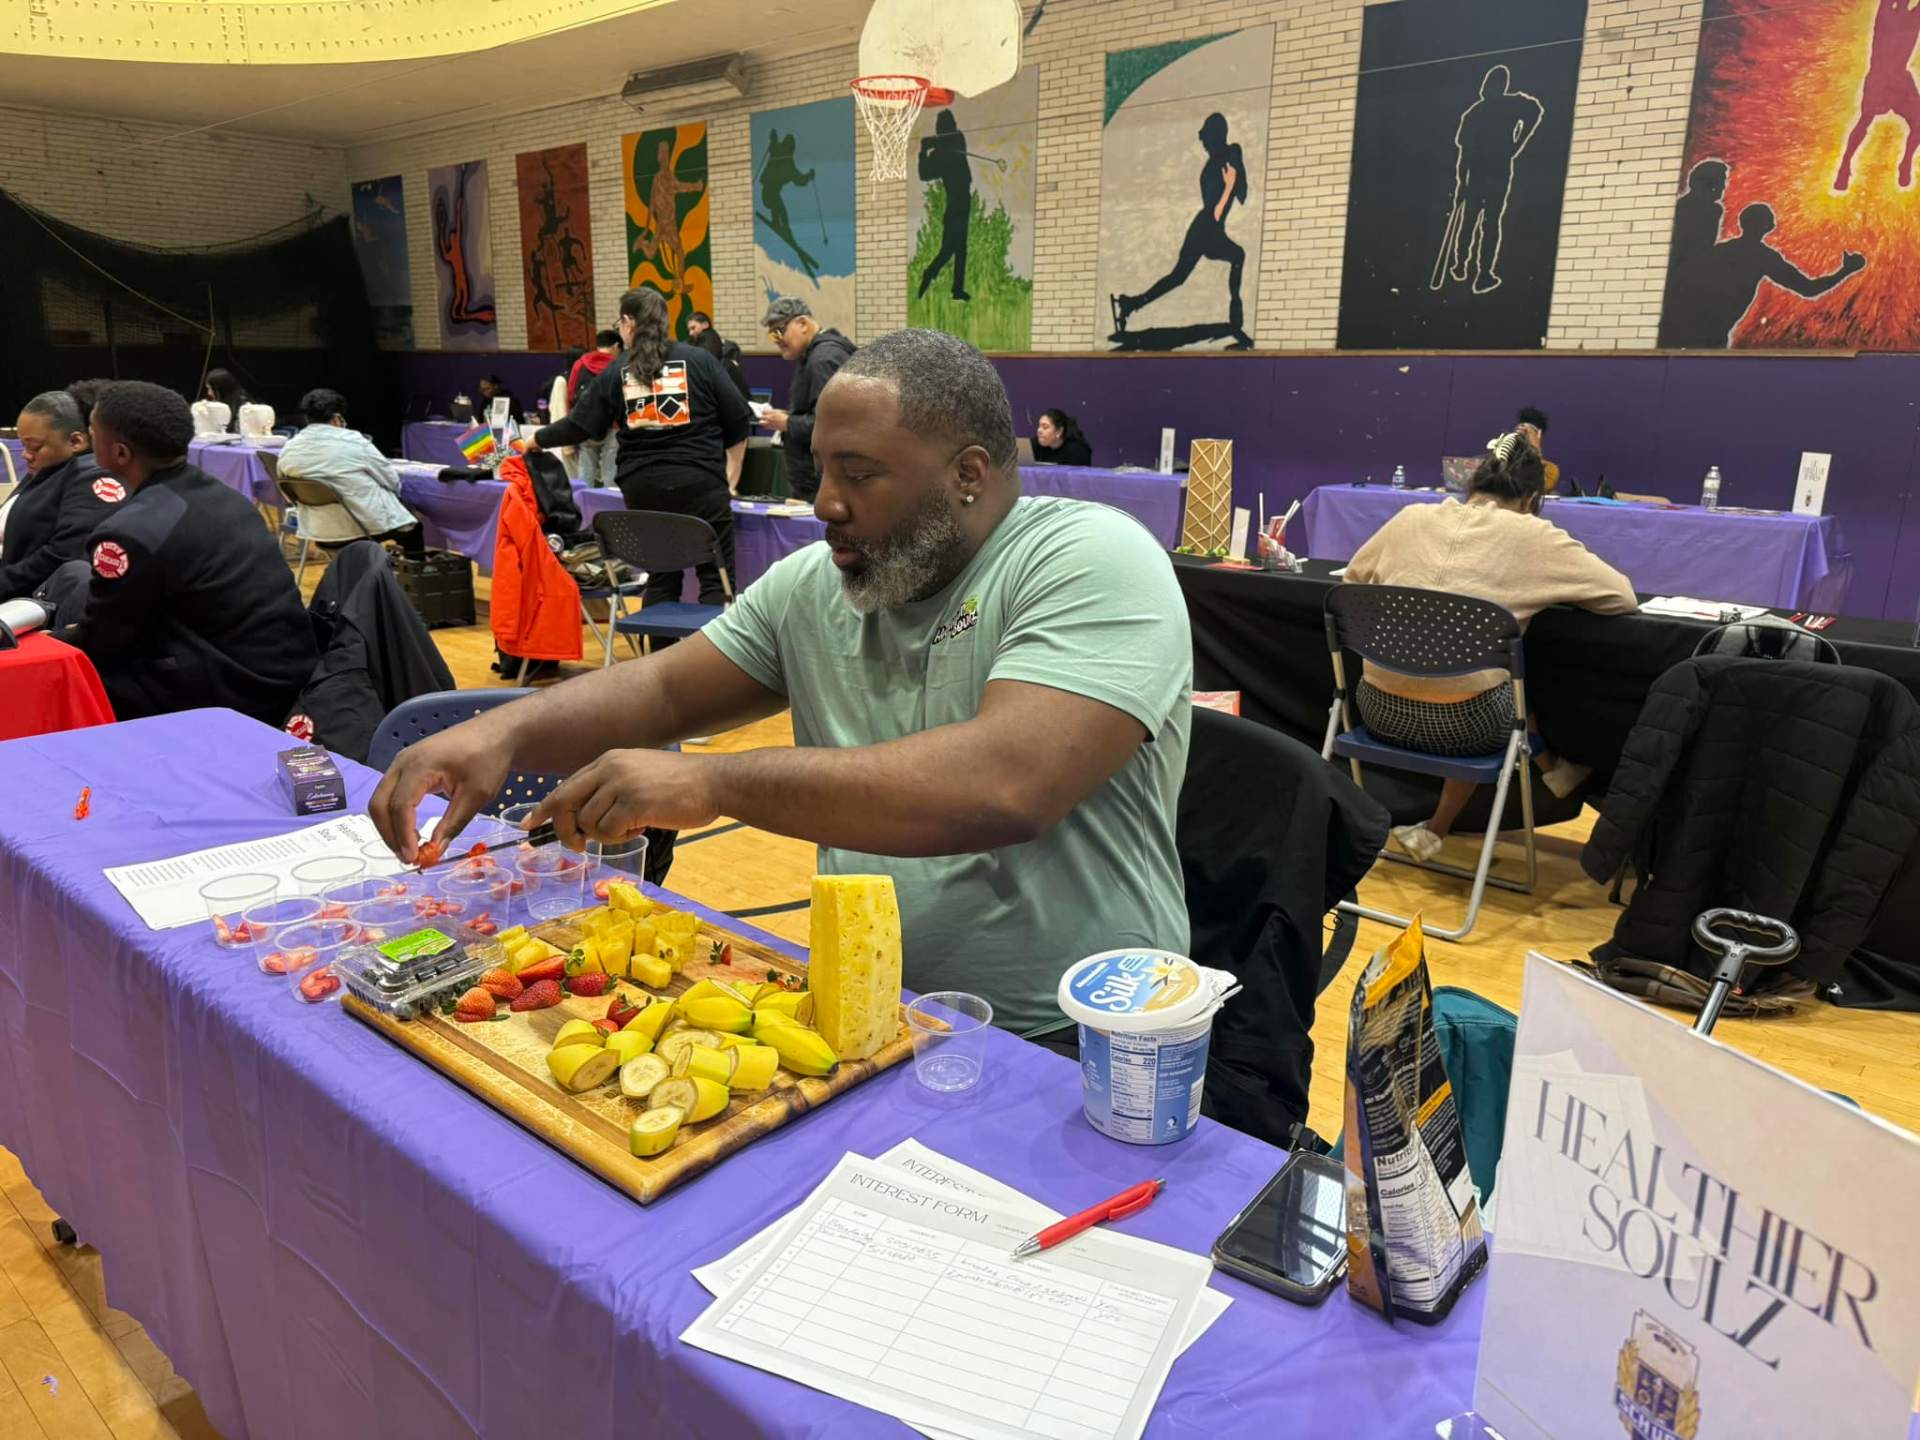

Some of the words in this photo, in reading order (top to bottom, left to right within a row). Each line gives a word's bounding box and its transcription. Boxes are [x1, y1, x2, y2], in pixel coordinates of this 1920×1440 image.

[1089, 972, 1147, 1012] Silk
[1139, 1034, 1157, 1042] Facts
[1143, 1057, 1156, 1065] 220
[850, 1173, 933, 1207] INTEREST
[932, 1200, 989, 1224] FORM
[1380, 1182, 1415, 1196] Calories
[1533, 1079, 1880, 1352] HEALTHIER
[1582, 1182, 1789, 1371] SOULZ
